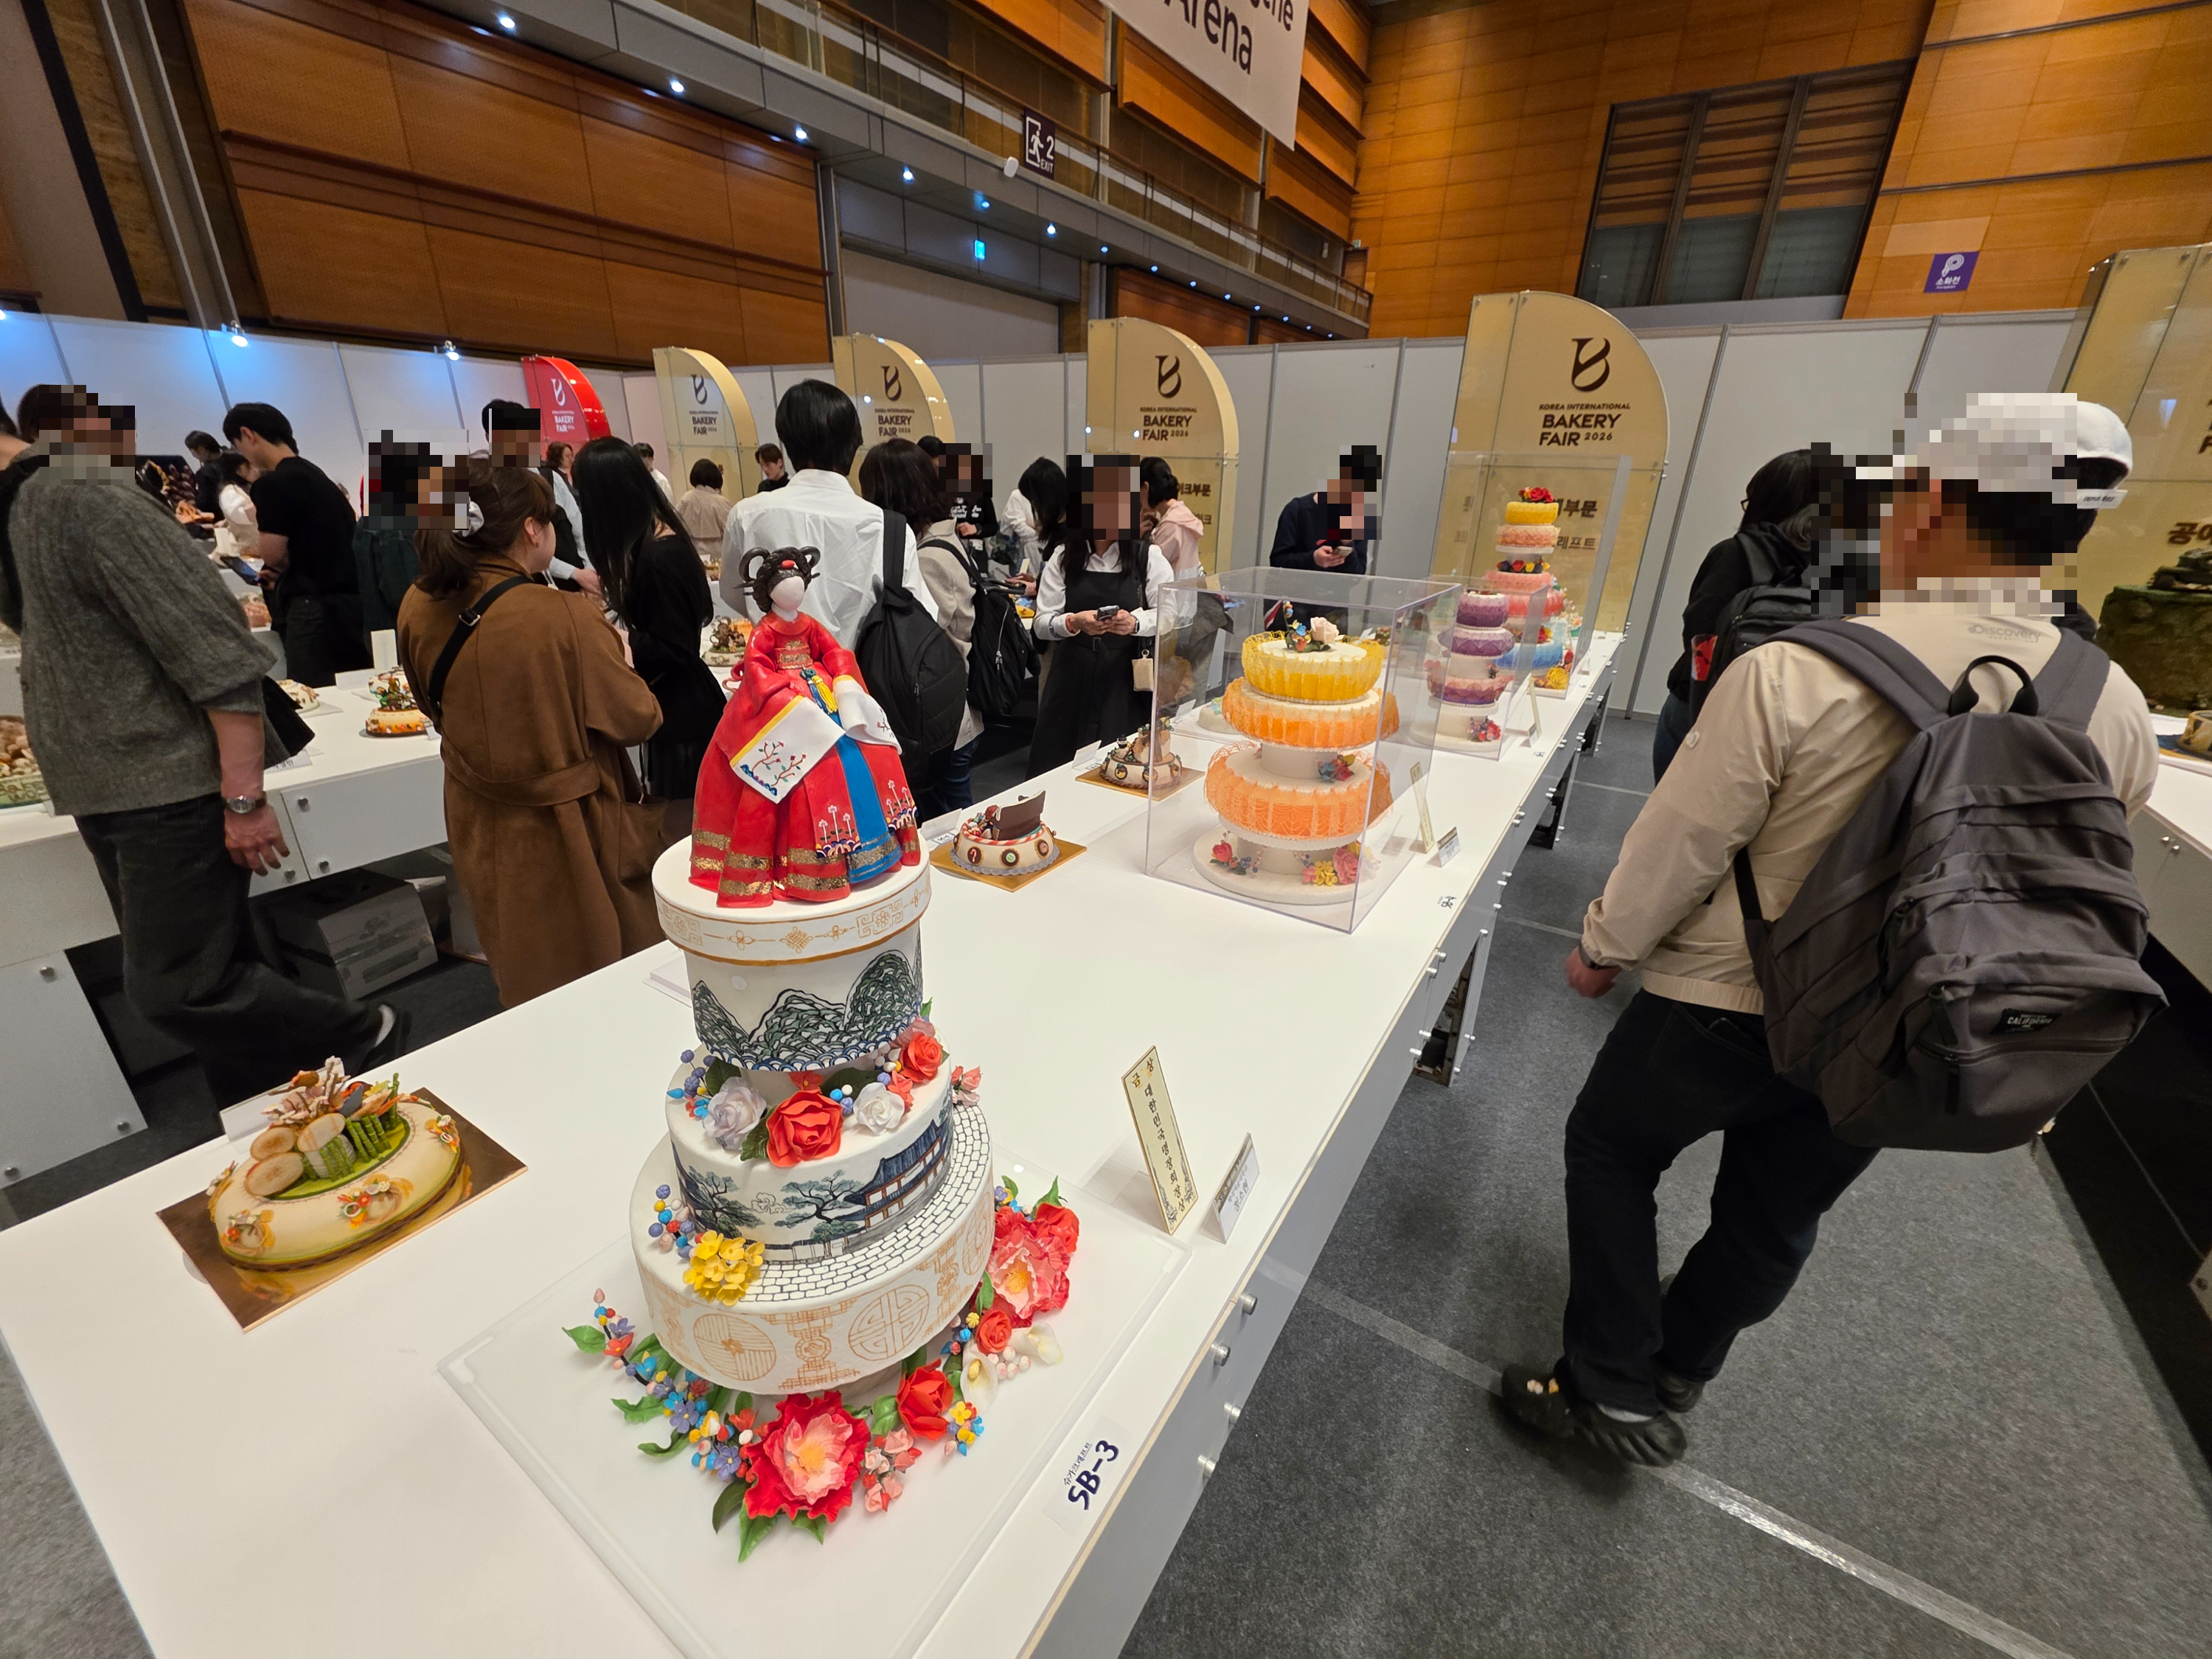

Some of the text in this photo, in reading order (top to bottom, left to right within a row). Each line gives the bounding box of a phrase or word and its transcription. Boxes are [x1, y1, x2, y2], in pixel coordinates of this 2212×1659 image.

[1046, 136, 1054, 160] 2
[1040, 159, 1054, 173] EXIT
[692, 416, 717, 425] BAKERY
[878, 414, 912, 425] BAKERY
[1143, 415, 1192, 428] BAKERY
[1542, 414, 1622, 428] BAKERY
[879, 426, 897, 437] FAIR
[1142, 429, 1169, 441] FAIR
[1539, 431, 1613, 446] FAIR 2026
[1068, 1440, 1119, 1511] SB-3
